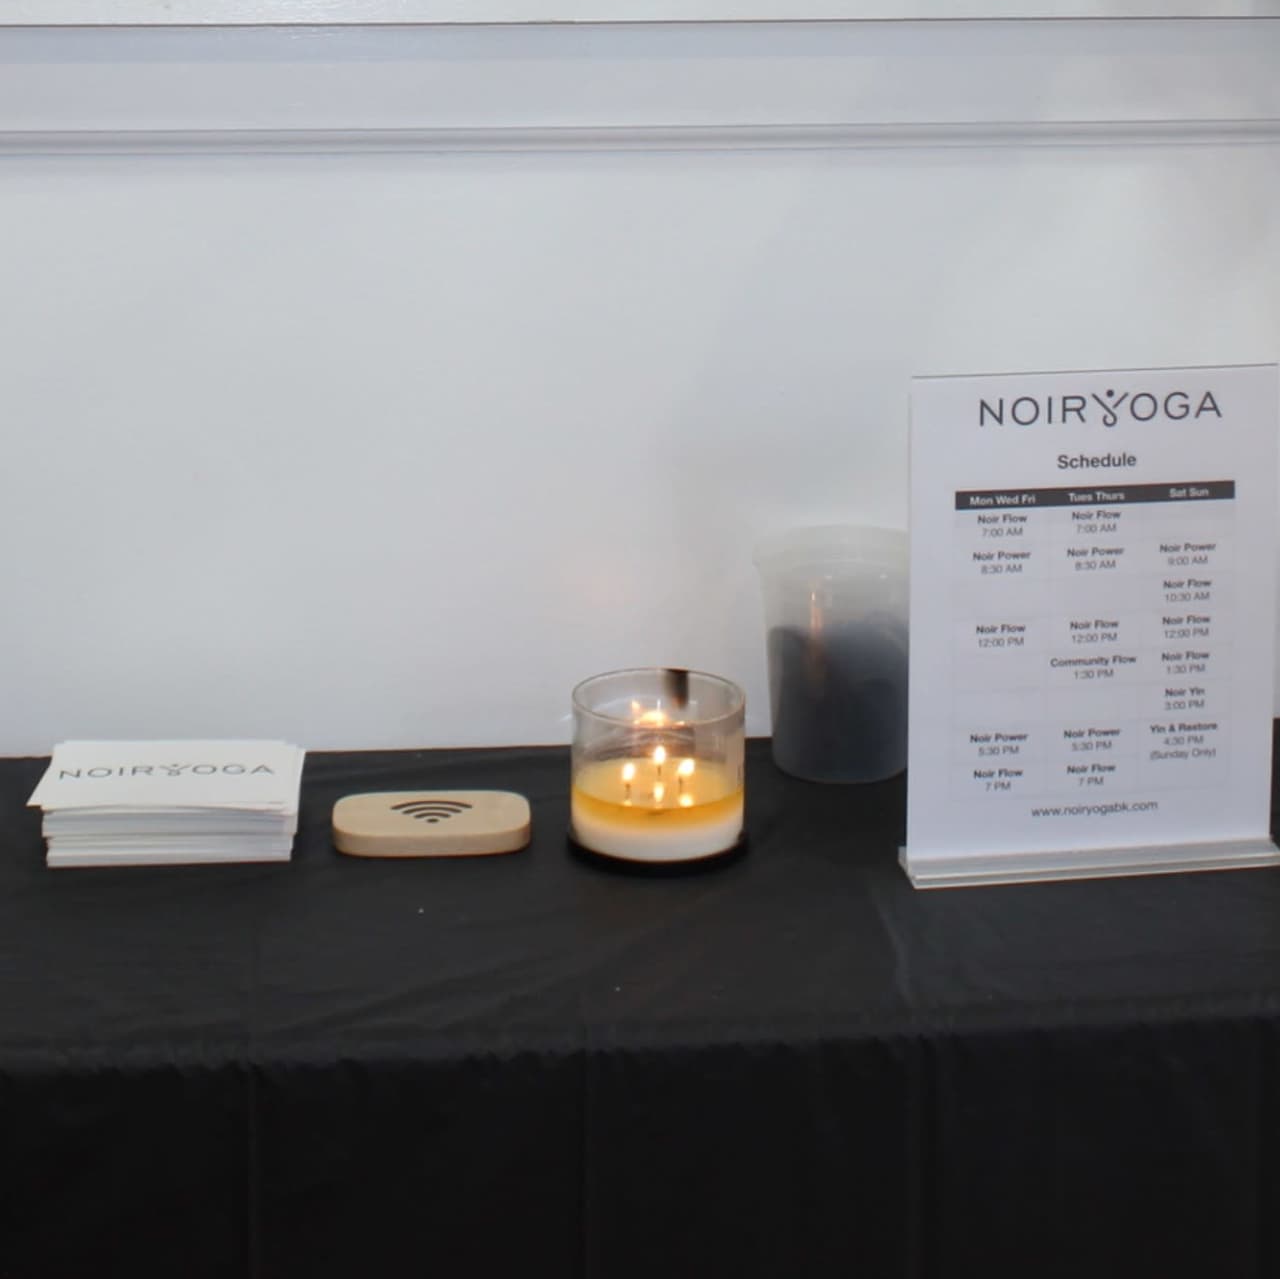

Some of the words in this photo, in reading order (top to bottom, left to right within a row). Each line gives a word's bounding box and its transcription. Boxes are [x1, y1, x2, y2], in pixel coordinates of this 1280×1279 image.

[979, 389, 1223, 428] NOIRYOGA
[1057, 451, 1137, 470] Schedule
[1068, 492, 1092, 502] Tues
[1094, 492, 1125, 501] Thurs
[1169, 488, 1186, 498] Sat
[1189, 488, 1210, 496] Sun
[970, 496, 993, 506] Mon
[996, 494, 1019, 504] Wed
[1022, 494, 1036, 504] Fri
[977, 514, 999, 524] Noir
[1002, 514, 1028, 523] Flow
[1072, 511, 1094, 520] Noir
[1096, 510, 1122, 519] Flow
[1006, 527, 1023, 536] AM
[1100, 523, 1117, 532] AM
[1067, 548, 1088, 558] Noir
[1091, 546, 1124, 556] Power
[1160, 544, 1181, 552] Noir
[1184, 542, 1216, 552] Power
[973, 552, 994, 562] Noir
[997, 550, 1032, 560] Power
[1163, 580, 1184, 589] Noir
[1187, 578, 1212, 588] Flow
[1070, 620, 1090, 630] Noir
[1094, 620, 1118, 629] Flow
[1162, 616, 1184, 626] Noir
[1186, 615, 1210, 624] Flow
[976, 624, 998, 634] Noir
[1000, 624, 1026, 634] Flow
[1050, 656, 1110, 668] Community
[1112, 654, 1137, 664] Flow
[1161, 652, 1182, 662] Noir
[1186, 650, 1210, 660] Flow
[1164, 688, 1186, 698] Noir
[970, 734, 992, 743] Noir
[994, 732, 1028, 742] Power
[1064, 729, 1085, 739] Noir
[1088, 728, 1121, 738] Power
[974, 770, 995, 780] Noir
[998, 768, 1024, 778] Flow
[1067, 765, 1088, 775] Noir
[1092, 764, 1116, 773] Flow
